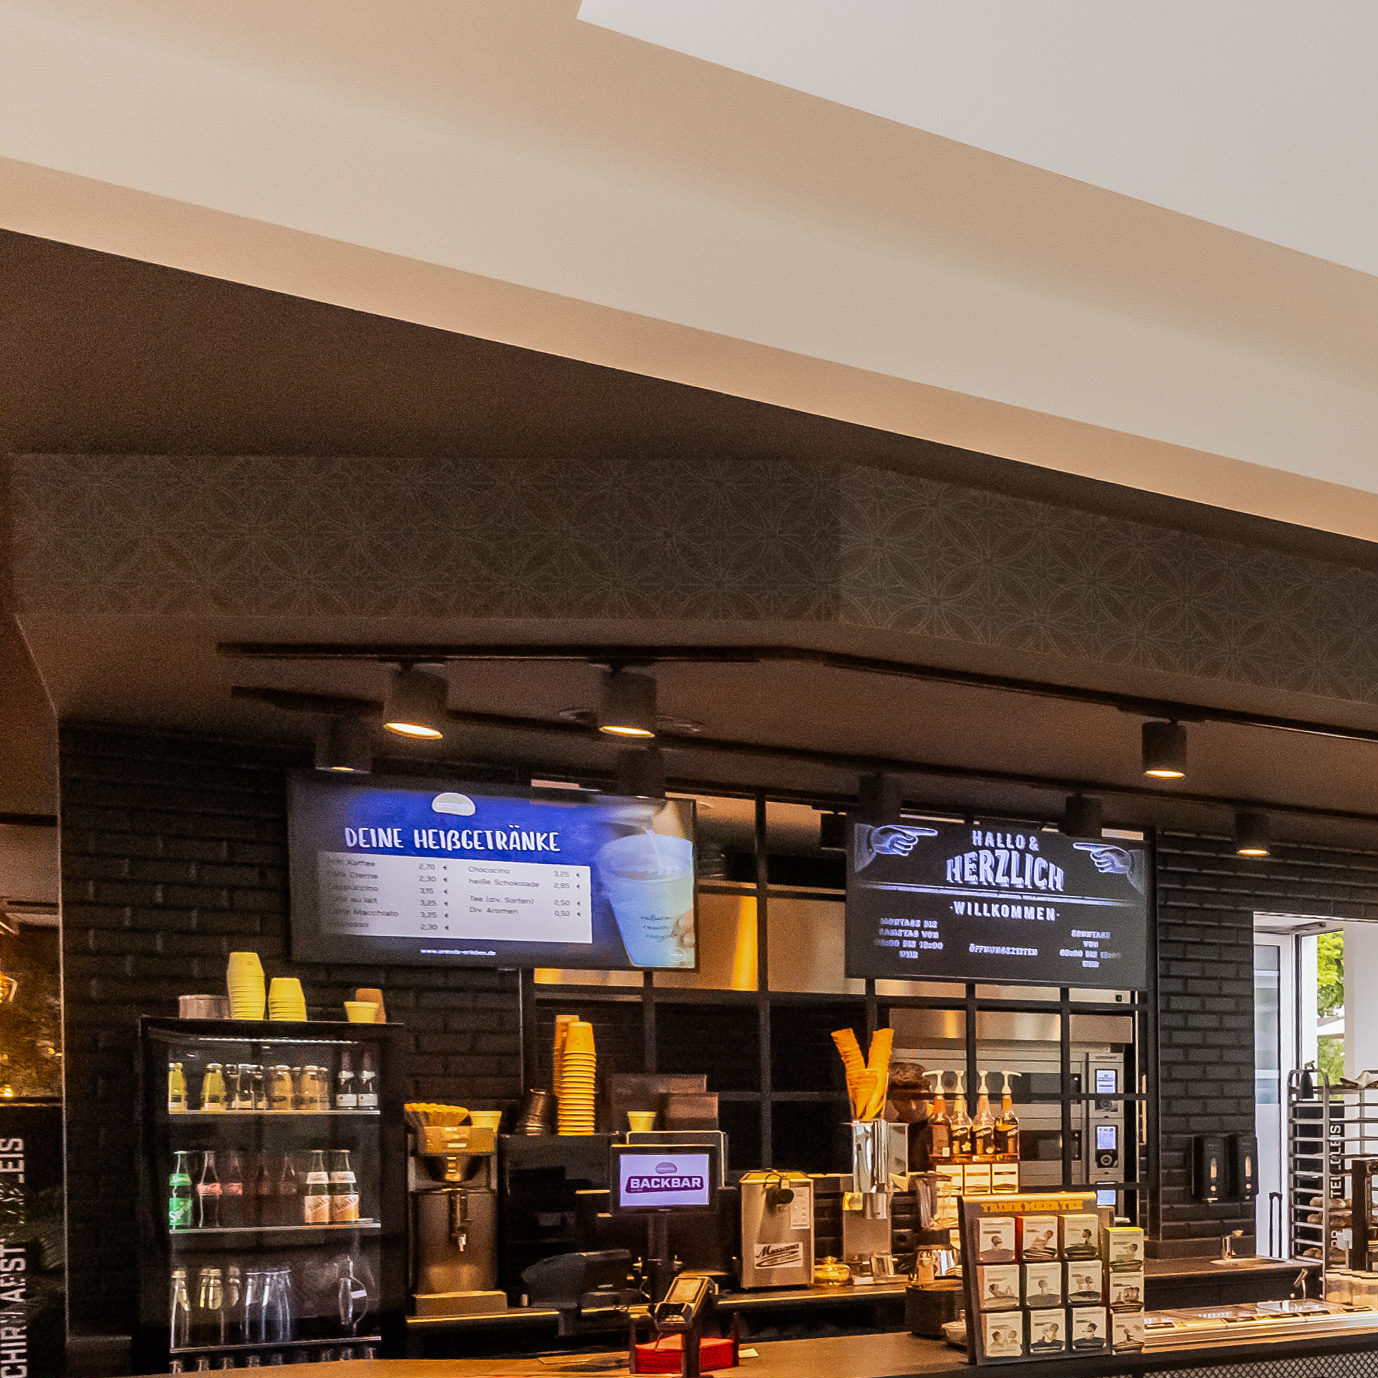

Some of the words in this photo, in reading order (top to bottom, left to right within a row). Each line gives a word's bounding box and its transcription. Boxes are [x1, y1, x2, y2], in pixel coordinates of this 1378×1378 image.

[345, 827, 404, 848] DEINE
[413, 825, 561, 851] HEIßGETRÄNKE
[972, 830, 1026, 849] HALLO
[1028, 836, 1040, 851] &
[946, 849, 1064, 892] HERZLICH
[953, 901, 1056, 921] WILLKOMMEN
[630, 1177, 702, 1190] BACKBAR
